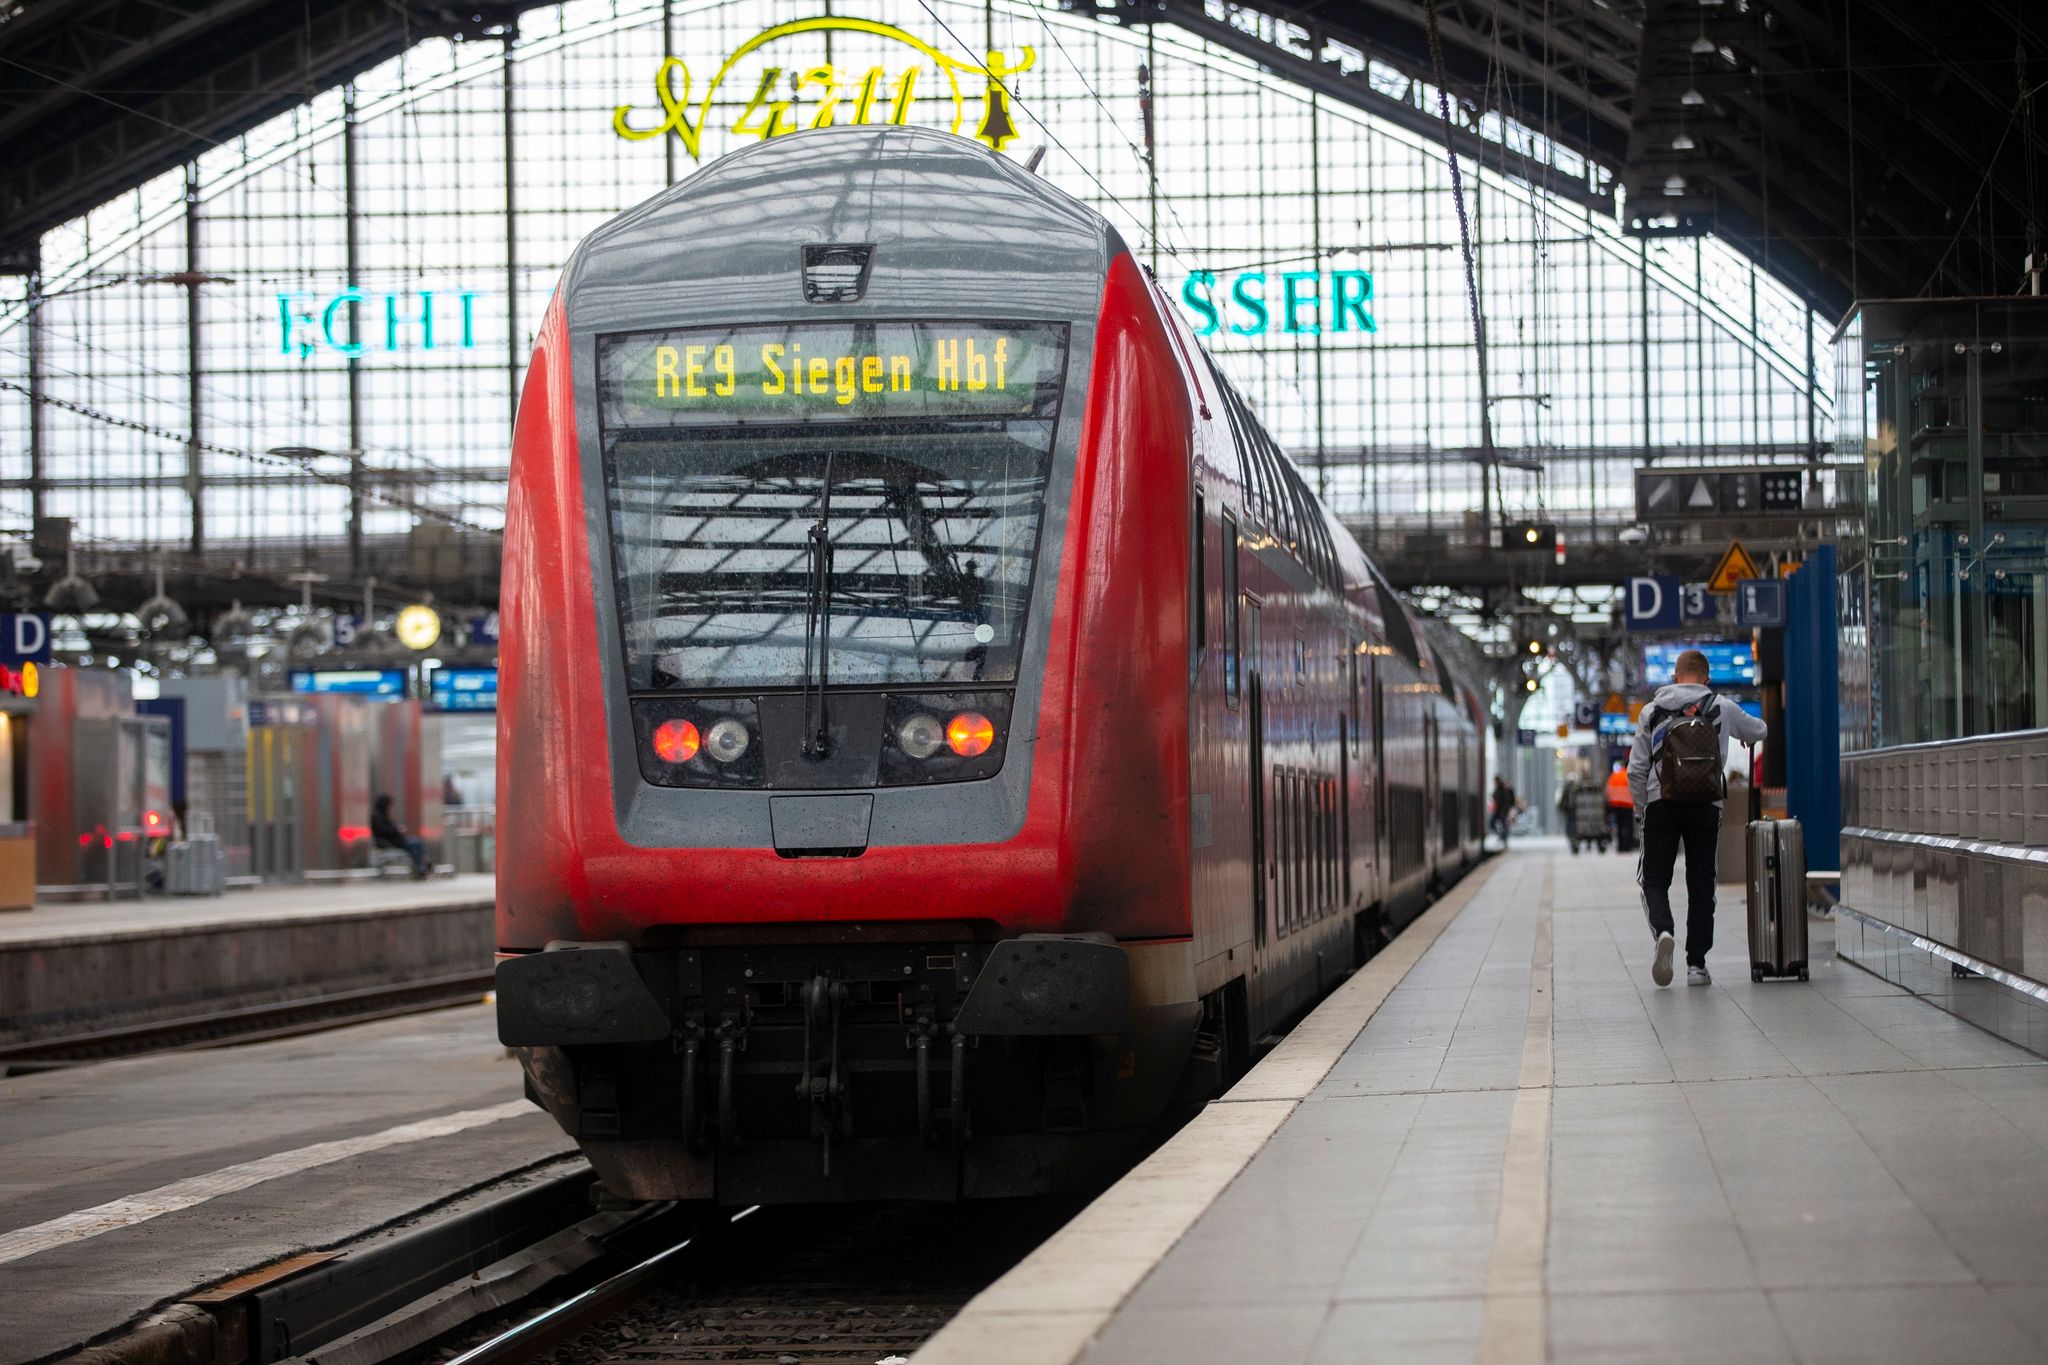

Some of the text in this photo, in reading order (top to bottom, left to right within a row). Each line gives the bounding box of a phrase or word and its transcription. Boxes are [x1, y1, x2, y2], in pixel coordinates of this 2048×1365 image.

[656, 337, 1007, 404] RE9 Siegen Hbf
[1631, 576, 1663, 620] D
[1686, 584, 1705, 616] 3
[14, 613, 45, 654] D
